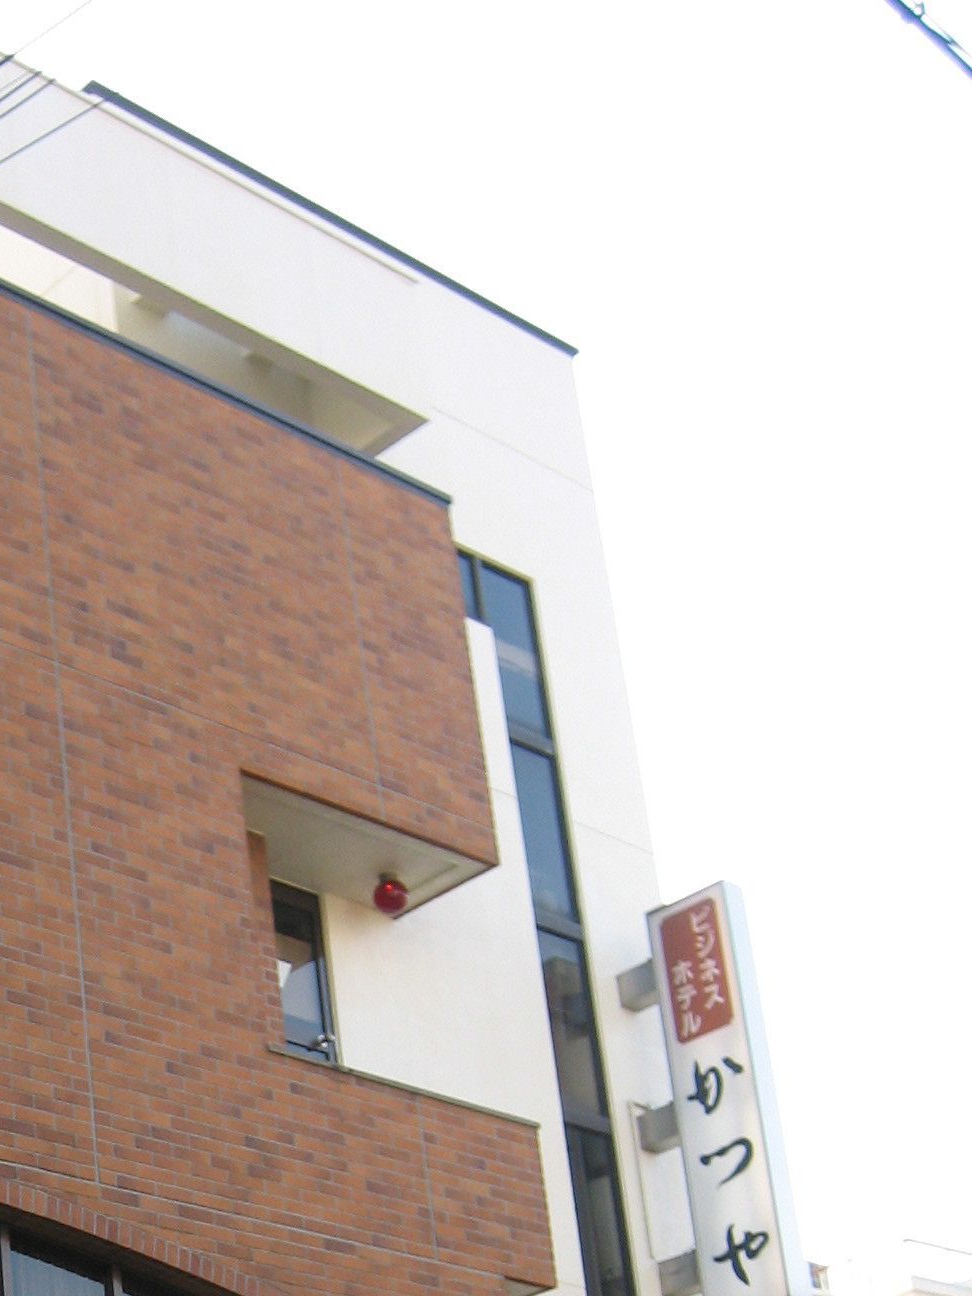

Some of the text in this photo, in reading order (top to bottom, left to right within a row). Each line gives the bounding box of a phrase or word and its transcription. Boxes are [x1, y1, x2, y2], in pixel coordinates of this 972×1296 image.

[671, 960, 702, 1038] ホテル
[687, 1056, 770, 1287] かつや
